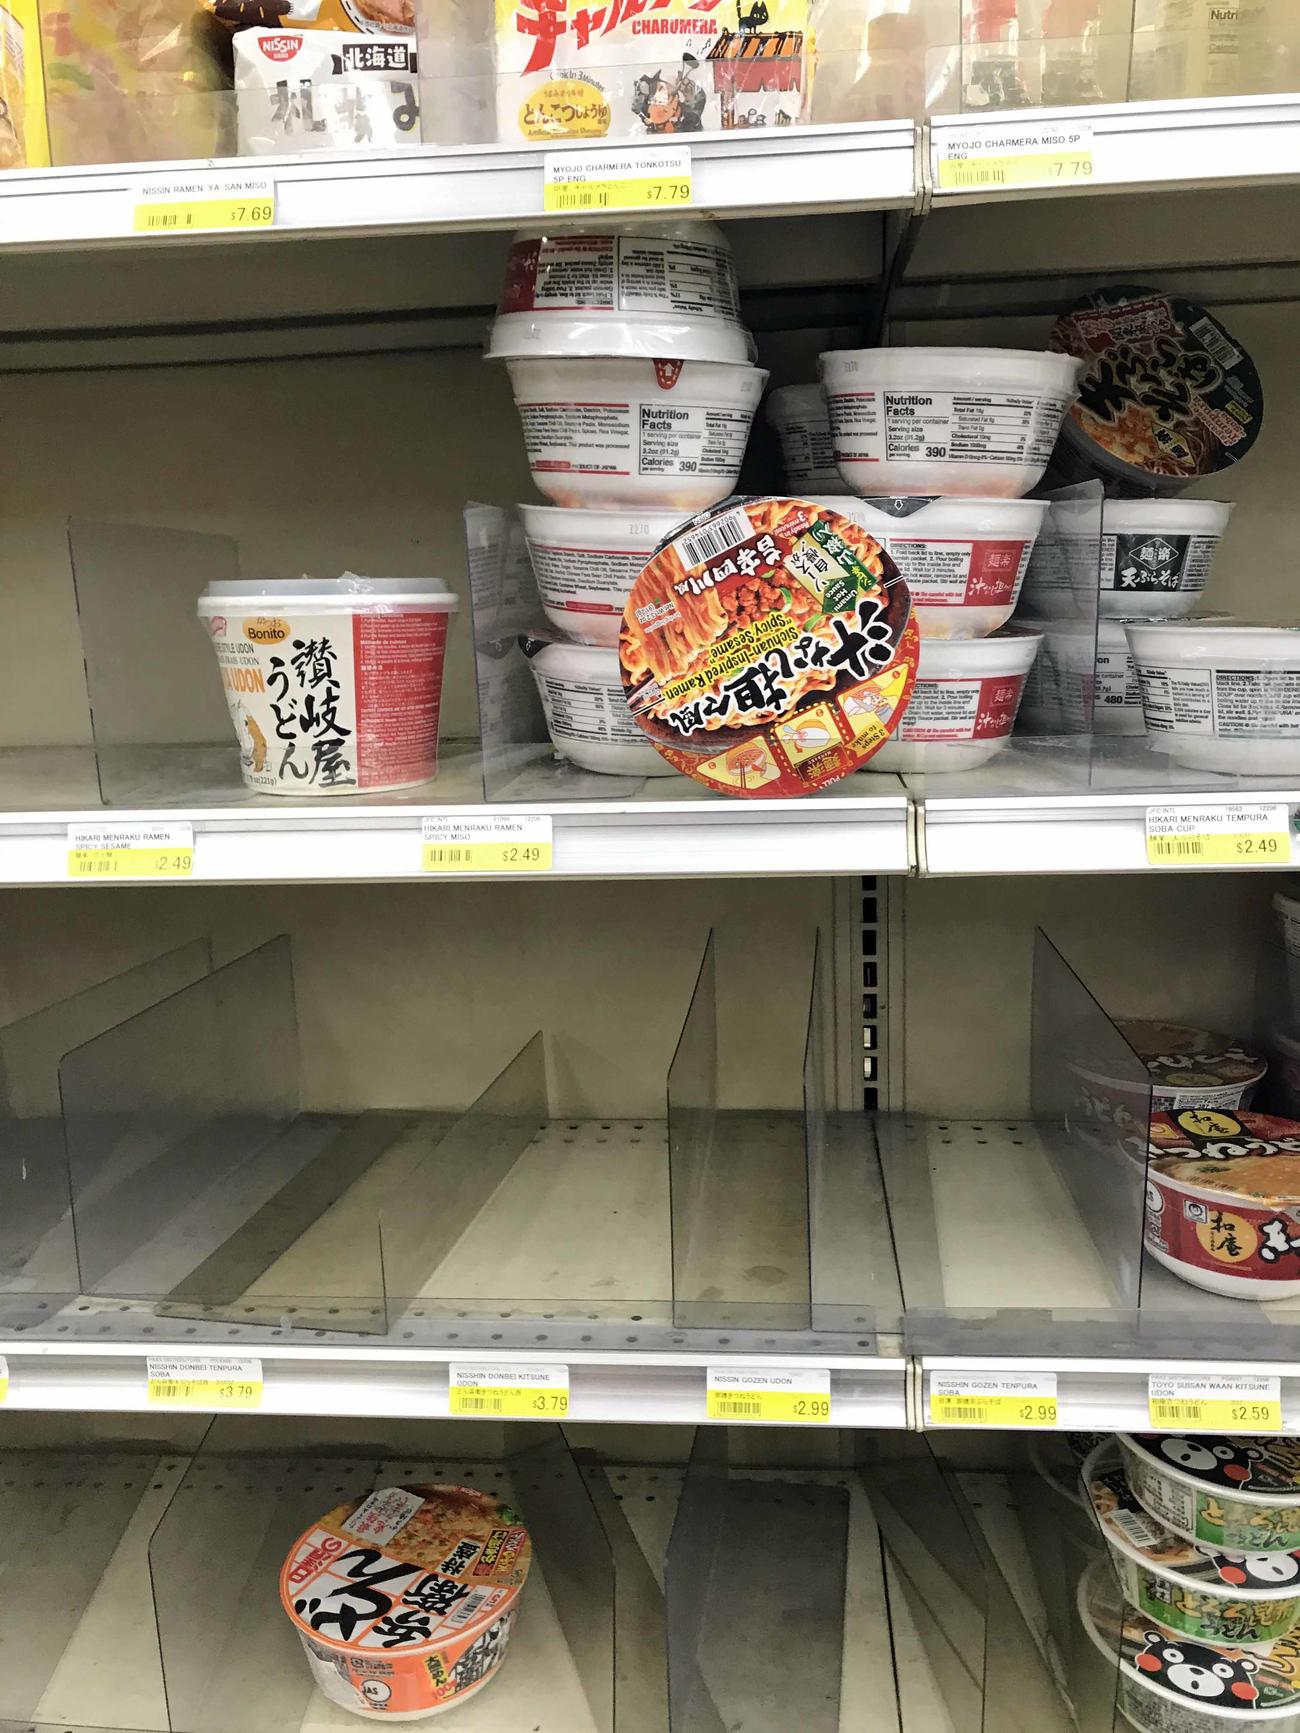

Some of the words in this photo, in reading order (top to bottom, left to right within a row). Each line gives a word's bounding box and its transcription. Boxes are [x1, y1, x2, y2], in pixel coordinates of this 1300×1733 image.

[632, 18, 718, 35] CHARUMERA
[263, 37, 298, 53] NISSIN
[344, 45, 407, 69] 北海道
[948, 141, 982, 151] MYOJO
[984, 137, 1038, 149] CHARMERA
[1041, 136, 1066, 145] MISO
[1068, 134, 1081, 143] 5P
[948, 152, 968, 161] ENG
[553, 165, 583, 174] MYOJO
[585, 162, 632, 172] CHARMERA
[636, 160, 682, 169] TONKOTSU
[1048, 160, 1093, 177] $779
[553, 176, 565, 184] 5P
[567, 174, 587, 183] ENG
[143, 186, 171, 195] NISSIN
[173, 184, 204, 194] RAMEN
[208, 183, 220, 192] YA
[224, 182, 243, 191] SAN
[245, 181, 267, 190] MISO
[647, 184, 690, 201] $7.79
[231, 206, 272, 222] $7.69
[886, 395, 933, 406] Nutrition
[642, 408, 689, 420] Nutrition
[886, 406, 915, 416] Facts
[642, 420, 673, 430] Facts
[888, 443, 920, 452] Calories
[925, 447, 947, 458] 390
[642, 457, 674, 466] Calories
[679, 461, 698, 472] 390
[797, 511, 806, 522] 3
[673, 534, 782, 596] 旨辛四川風
[1120, 566, 1182, 589] 天ぷらそば
[825, 580, 845, 598] Sauce
[832, 588, 848, 602] Hot
[833, 589, 858, 612] Umami
[247, 627, 285, 640] Bonito
[237, 643, 255, 654] UDON
[706, 626, 800, 683] Sichuan-Inspired
[241, 656, 260, 666] UDON
[669, 602, 893, 734] 汁なし担々風
[231, 667, 266, 693] UDON
[665, 672, 707, 701] Ramen
[1104, 695, 1123, 705] 480
[266, 655, 309, 782] うどん
[867, 725, 878, 734] to
[851, 731, 870, 749] make
[861, 733, 879, 750] Steps
[818, 774, 841, 789] PULL
[1148, 816, 1178, 824] HIKARI
[1180, 814, 1223, 823] MENRAKU
[1226, 813, 1269, 822] TEMPURA
[424, 824, 451, 832] HIKARI
[453, 824, 492, 832] MENRAKU
[1148, 825, 1174, 833] SOBA
[75, 834, 101, 842] HIKARI
[103, 833, 140, 841] MENRAKU
[143, 833, 170, 841] RAMEN
[424, 833, 448, 841] SPICY
[100, 842, 132, 850] SESAME
[1236, 838, 1278, 854] $2.49
[502, 847, 540, 862] $2.49
[154, 855, 191, 870] $249
[149, 1364, 177, 1372] NISSHIN
[179, 1364, 208, 1372] DONBEI
[457, 1372, 486, 1380] NISSHIN
[488, 1372, 517, 1380] DONBEI
[519, 1373, 550, 1381] KITSUNE
[770, 1377, 793, 1385] UDON
[219, 1385, 253, 1400] $379
[937, 1381, 969, 1389] NISSHIN
[1000, 1382, 1038, 1390] TENPURA
[1151, 1381, 1174, 1389] TOYO
[1235, 1383, 1270, 1391] KITSUNE
[532, 1396, 568, 1411] $3.79
[793, 1400, 829, 1416] $2.99
[1019, 1405, 1057, 1421] $2.99
[1231, 1406, 1270, 1421] $2.59
[363, 1685, 379, 1696] JAS
